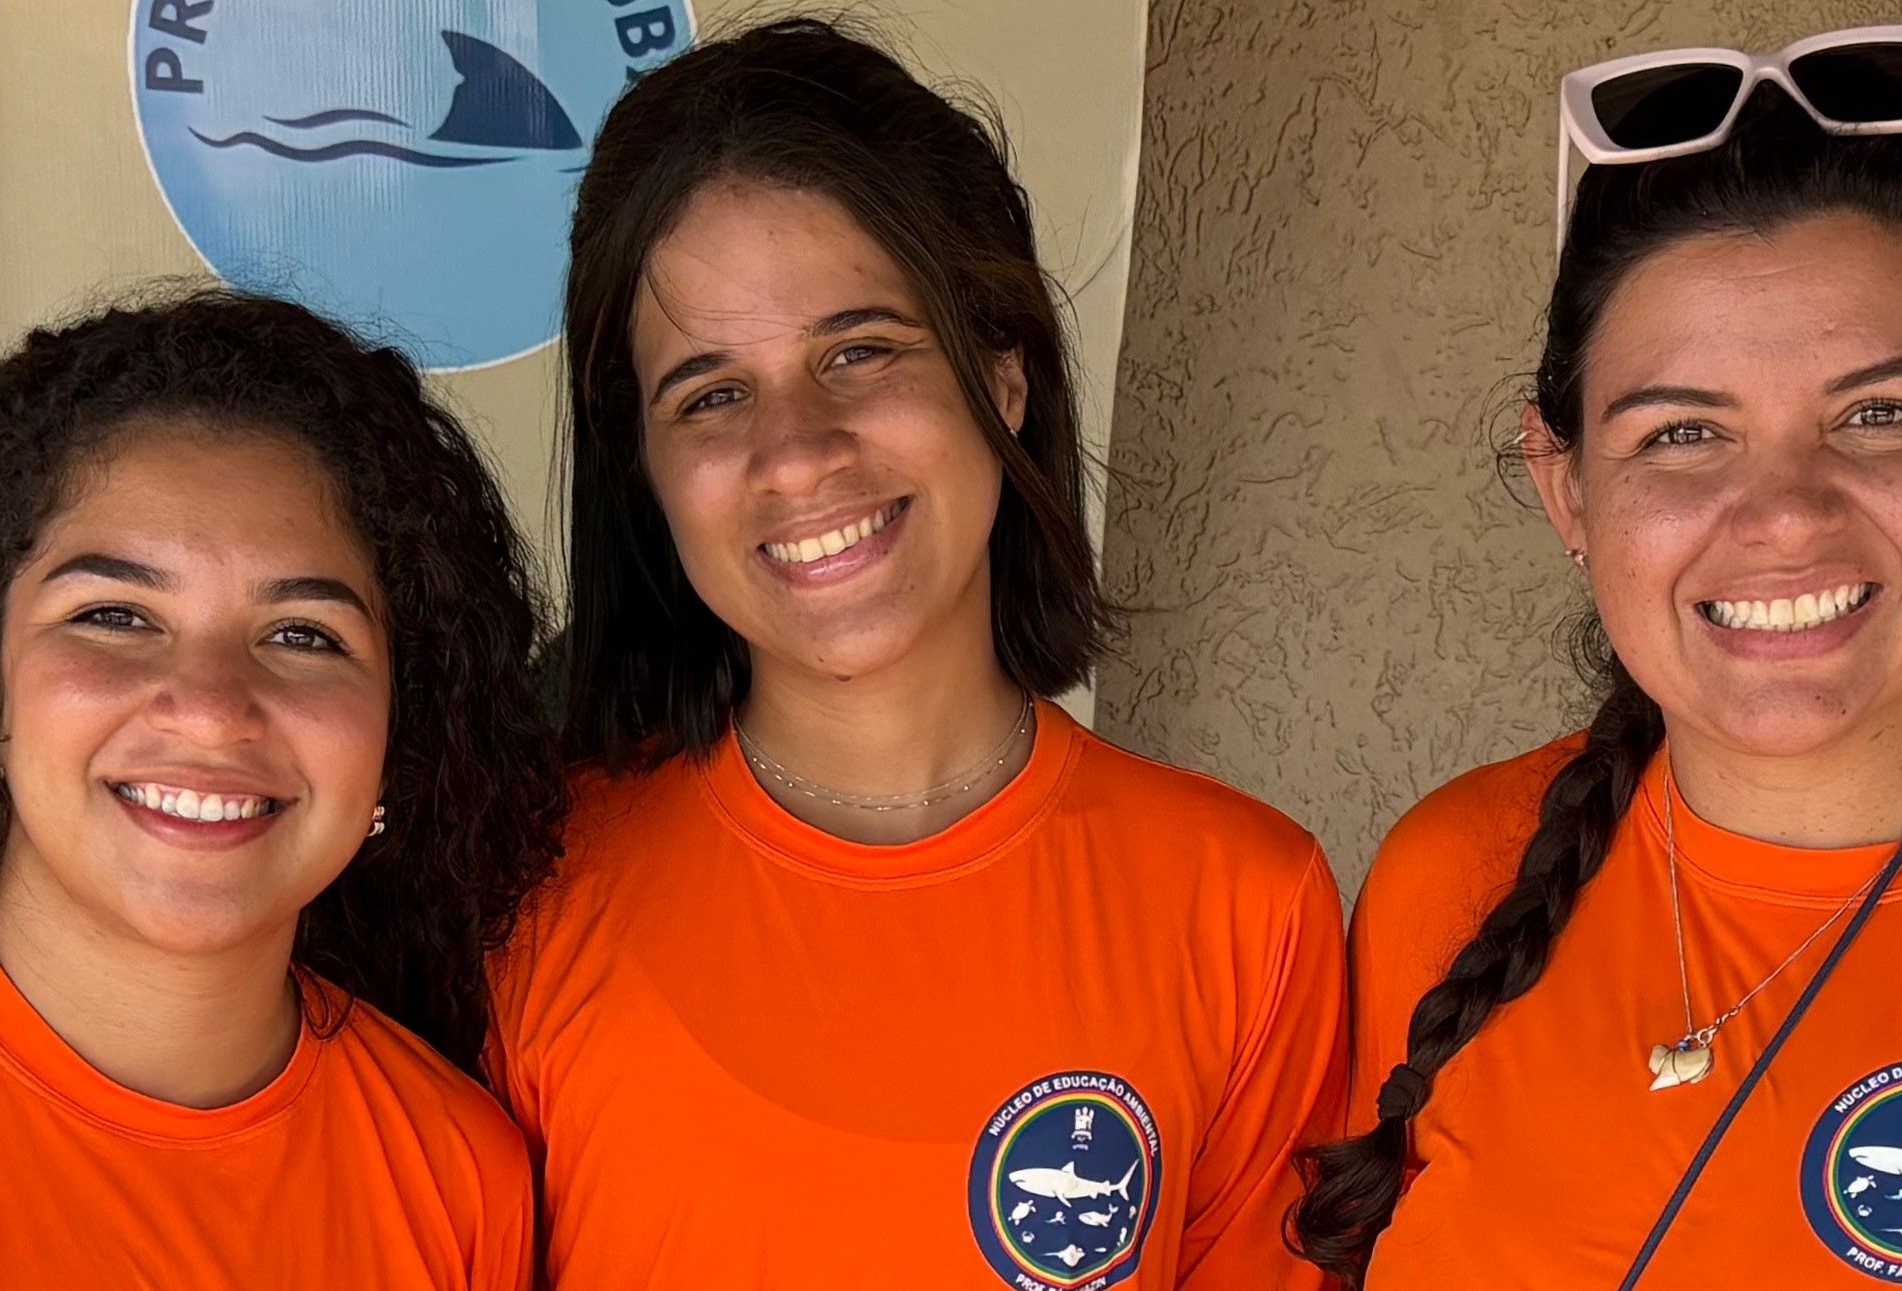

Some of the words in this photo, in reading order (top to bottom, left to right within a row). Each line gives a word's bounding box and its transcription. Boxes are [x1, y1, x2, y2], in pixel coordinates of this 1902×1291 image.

[988, 1091, 1031, 1137] NÚCLEO
[1034, 1082, 1052, 1098] DE
[1053, 1075, 1125, 1098] EDUCAÇÃO
[1834, 1071, 1889, 1114] NÚCLEO
[1846, 1246, 1884, 1274] PROF.
